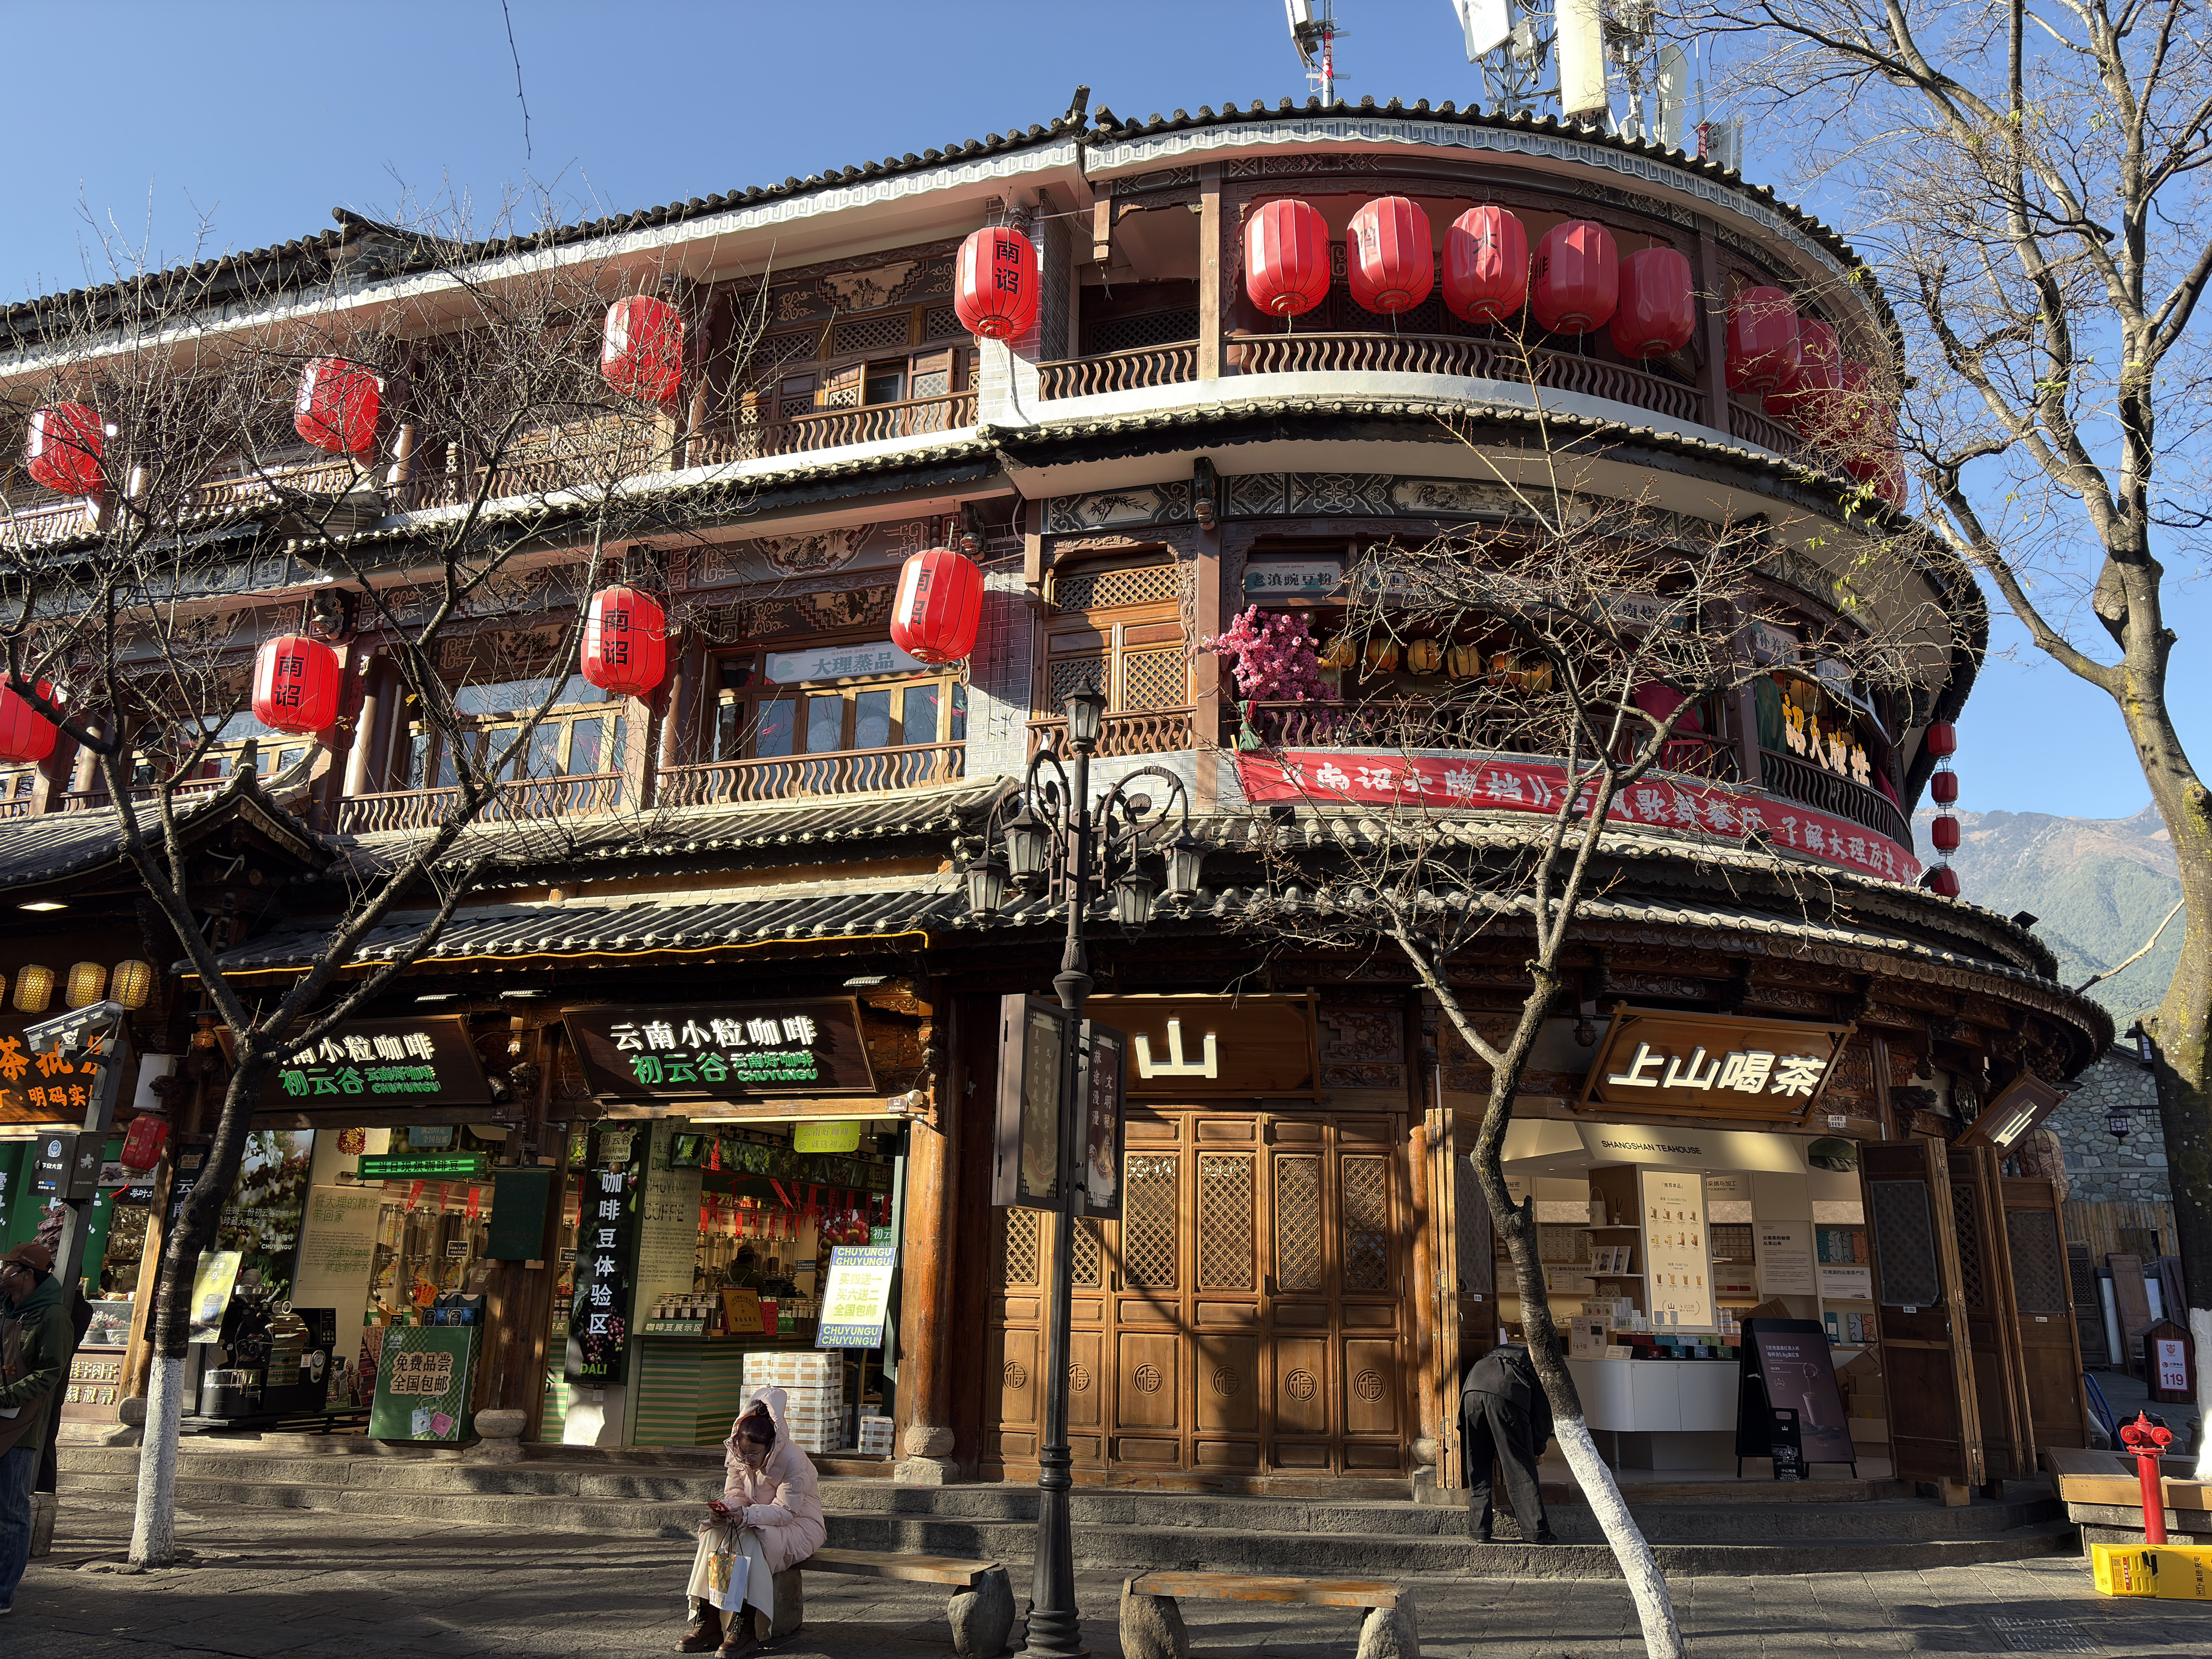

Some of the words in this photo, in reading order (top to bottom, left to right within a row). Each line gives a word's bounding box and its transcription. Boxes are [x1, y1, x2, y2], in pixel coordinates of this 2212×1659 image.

[995, 240, 1020, 294] 南诏
[1251, 572, 1333, 587] 老滇豌豆粉
[603, 608, 629, 665] 南诏
[811, 651, 895, 677] 大理蒸品
[274, 654, 304, 707] 南诏
[610, 1016, 818, 1051] 云南小粒咖啡
[1135, 1018, 1218, 1079] 山
[629, 1052, 729, 1084] 初云谷
[730, 1050, 815, 1068] 云南好咖啡
[1606, 1042, 1827, 1097] 上山喝茶
[278, 1067, 364, 1097] 初云谷
[364, 1065, 436, 1081] 云南好咖啡
[737, 1068, 818, 1082] CHUYUNGU
[372, 1081, 441, 1093] CHUYUNGU
[1092, 1050, 1102, 1126] 旅途漫漫
[1103, 1074, 1113, 1147] 文明相伴
[804, 1128, 850, 1137] 云南好咖啡
[601, 1134, 631, 1146] 初云谷
[811, 1139, 856, 1149] 就选初云谷
[1601, 1140, 1655, 1151] SHANGSHAN
[1656, 1145, 1702, 1155] TEAHOUSE
[378, 1160, 459, 1172] 当日现烘咖啡豆
[315, 1194, 379, 1211] 将大理的精华
[225, 1206, 296, 1219] 在每一份初云谷咖啡中
[312, 1208, 346, 1223] 带回家
[222, 1217, 268, 1228] 珍藏大理之美
[589, 1173, 623, 1334] 咖啡豆体验区
[837, 1248, 891, 1256] CHUYUNGU
[836, 1257, 890, 1266] CHUYUNGU
[838, 1273, 883, 1285] 买四送一
[836, 1288, 879, 1301] 买六送二
[833, 1303, 878, 1317] 全国包邮
[646, 1323, 703, 1332] 咖啡豆展示区
[823, 1326, 878, 1335] CHUYUNGU
[821, 1335, 877, 1345] CHUYUNGU
[394, 1354, 452, 1373] 免费品尝
[580, 1363, 608, 1375] DALI
[392, 1374, 449, 1392] 全国包邮
[2163, 1373, 2184, 1386] 119
